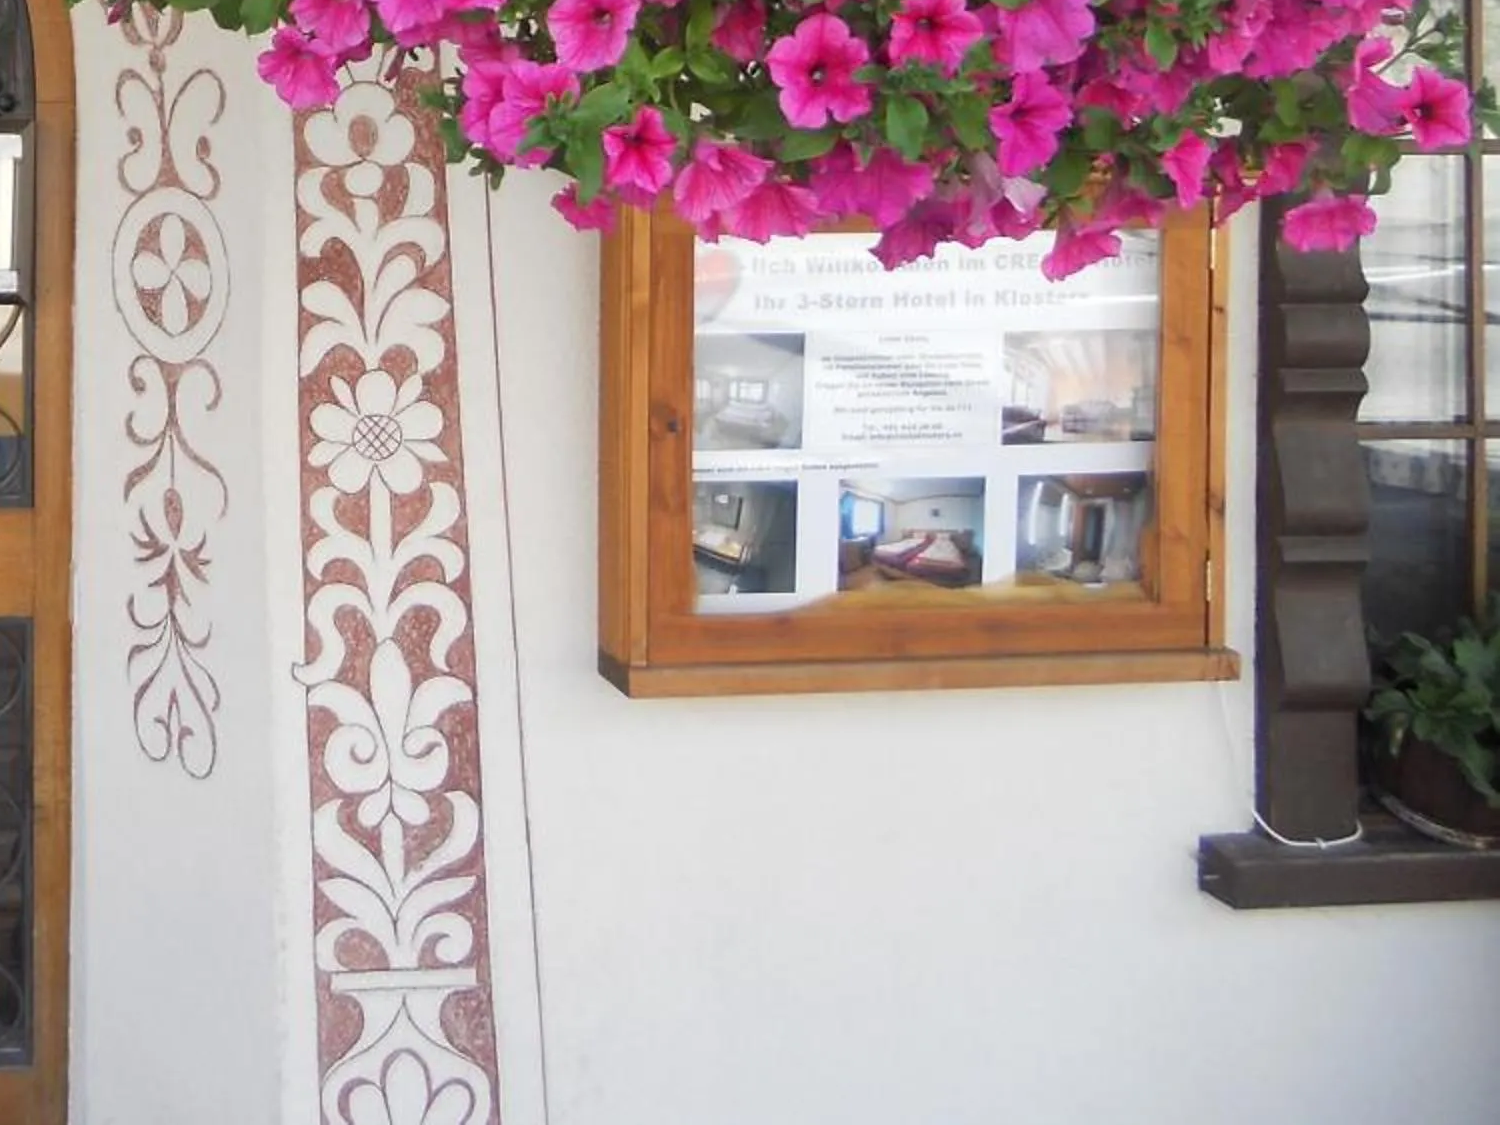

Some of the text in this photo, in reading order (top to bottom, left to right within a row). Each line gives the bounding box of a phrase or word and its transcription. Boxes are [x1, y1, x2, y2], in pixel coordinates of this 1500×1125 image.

[755, 293, 787, 310] Ihr
[797, 292, 884, 309] 3-Stern
[893, 289, 956, 308] Hotel
[964, 288, 985, 307] in
